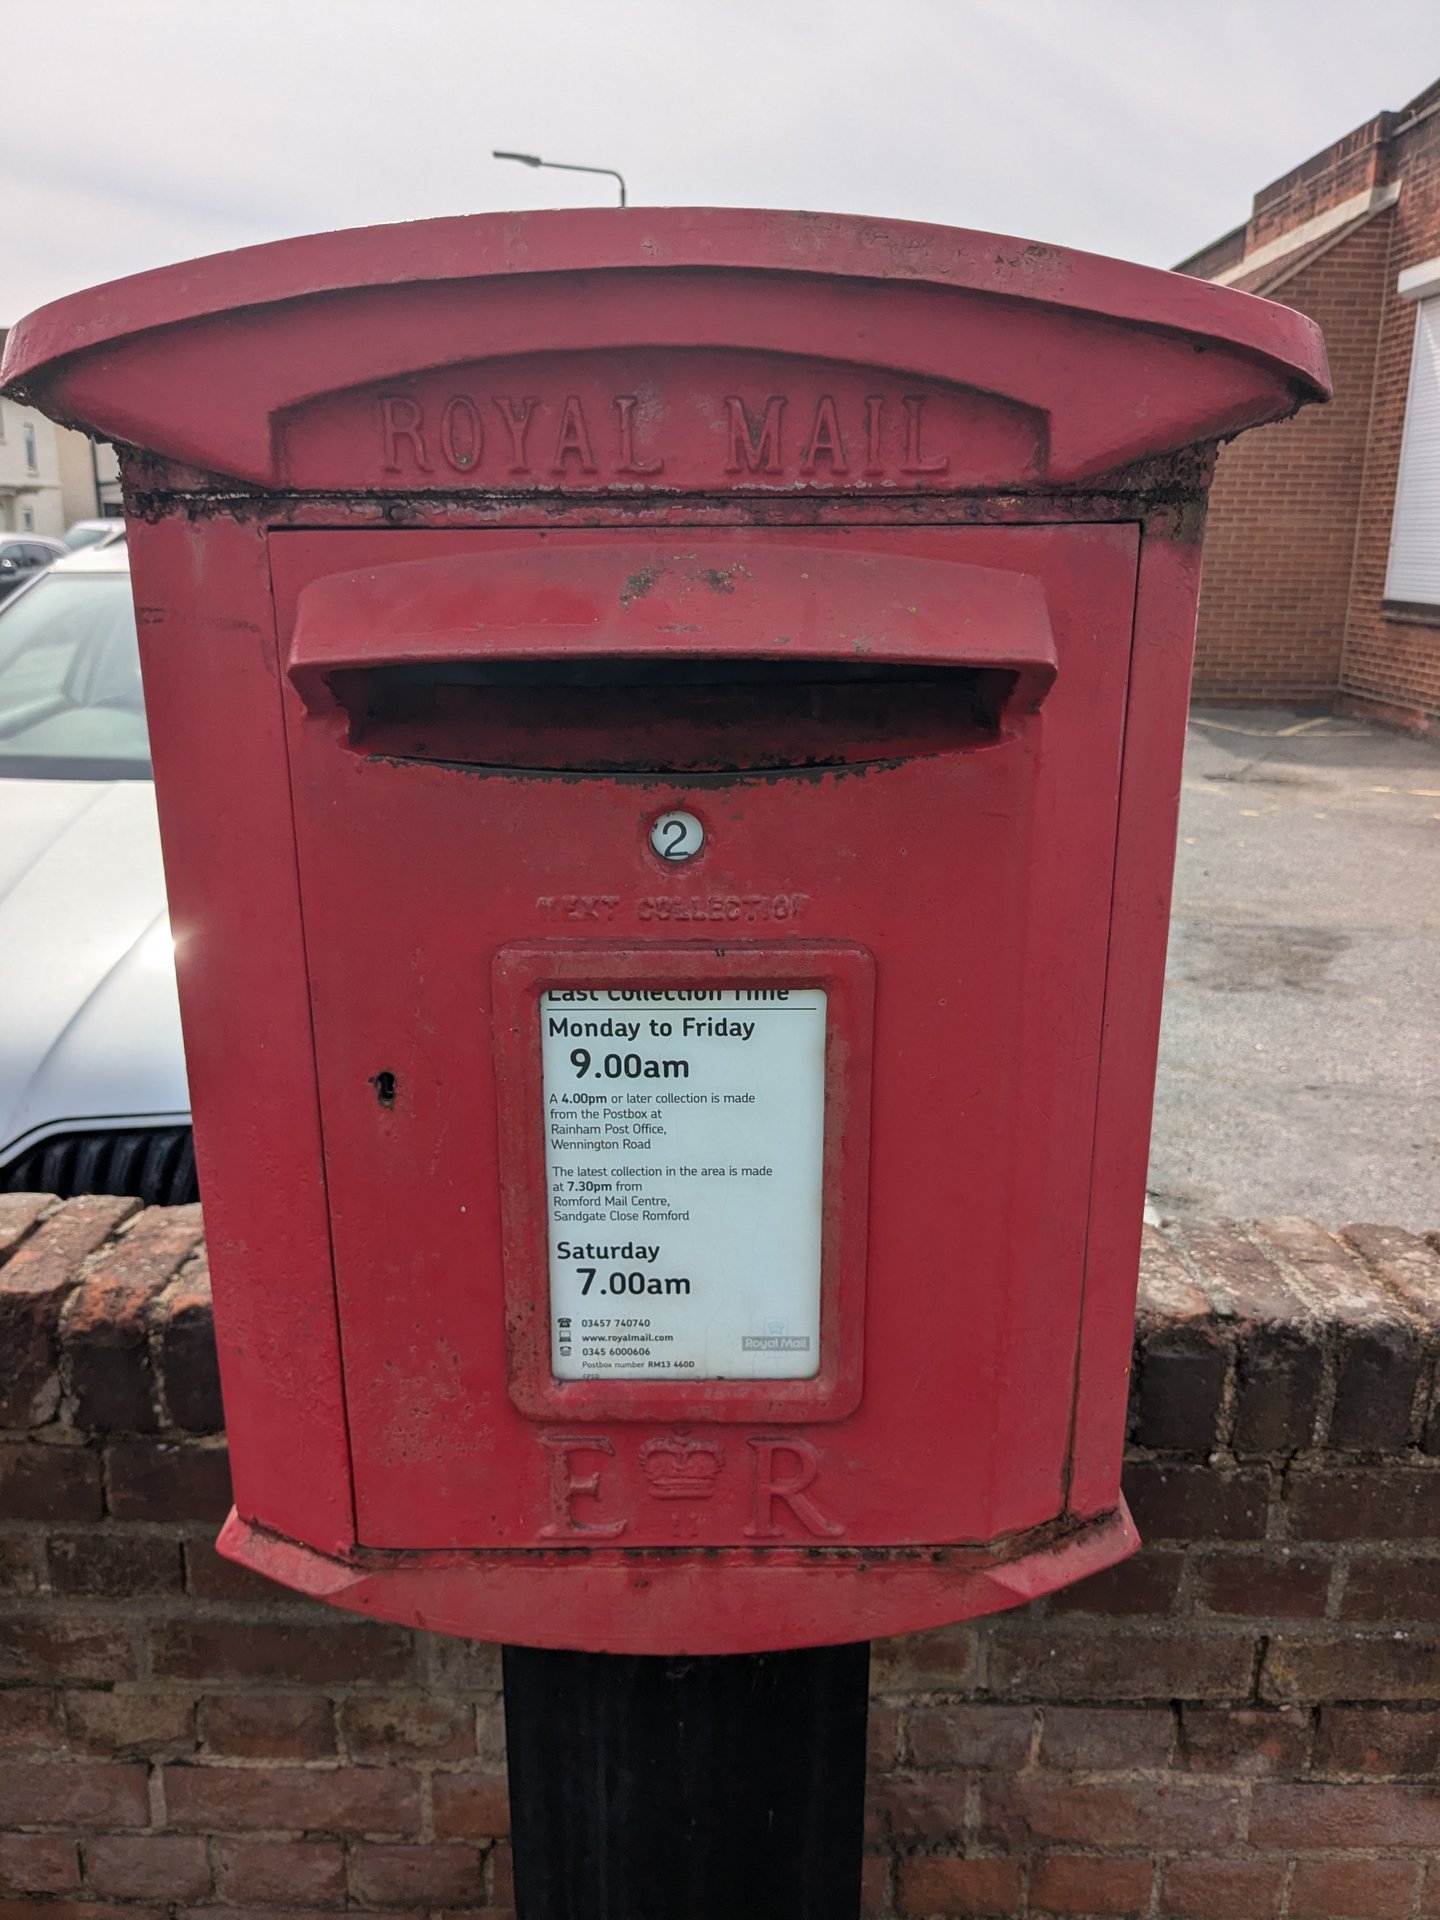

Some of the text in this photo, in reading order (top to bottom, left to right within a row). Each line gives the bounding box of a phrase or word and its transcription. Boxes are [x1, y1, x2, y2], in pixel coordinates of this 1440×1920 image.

[379, 395, 950, 475] ROYAL MAIL
[662, 820, 689, 857] 2
[548, 1016, 756, 1042] Monday to Friday
[569, 1047, 690, 1079] 9.00am
[548, 1092, 756, 1107] A 4.00pm or later collection is made
[549, 1107, 663, 1120] from the Postbox at
[550, 1122, 667, 1136] Rainham Post Office,
[550, 1138, 652, 1152] Wennington Road
[551, 1165, 773, 1177] The latest collection in the area is made
[552, 1180, 643, 1194] at 7.30pm from
[553, 1195, 671, 1208] Romford Mail Centre,
[553, 1209, 690, 1224] Sandgate Close Romford
[556, 1241, 661, 1264] Saturday
[575, 1267, 691, 1296] 7.00am
[581, 1318, 651, 1328] 03457 740740
[581, 1333, 674, 1344] www.royalmail.com
[745, 1338, 808, 1350] Royal Mail
[582, 1347, 651, 1356] 0345 6000606
[582, 1360, 613, 1369] Postbox
[614, 1361, 645, 1369] number
[647, 1360, 671, 1369] RM13
[535, 1435, 847, 1539] E R
